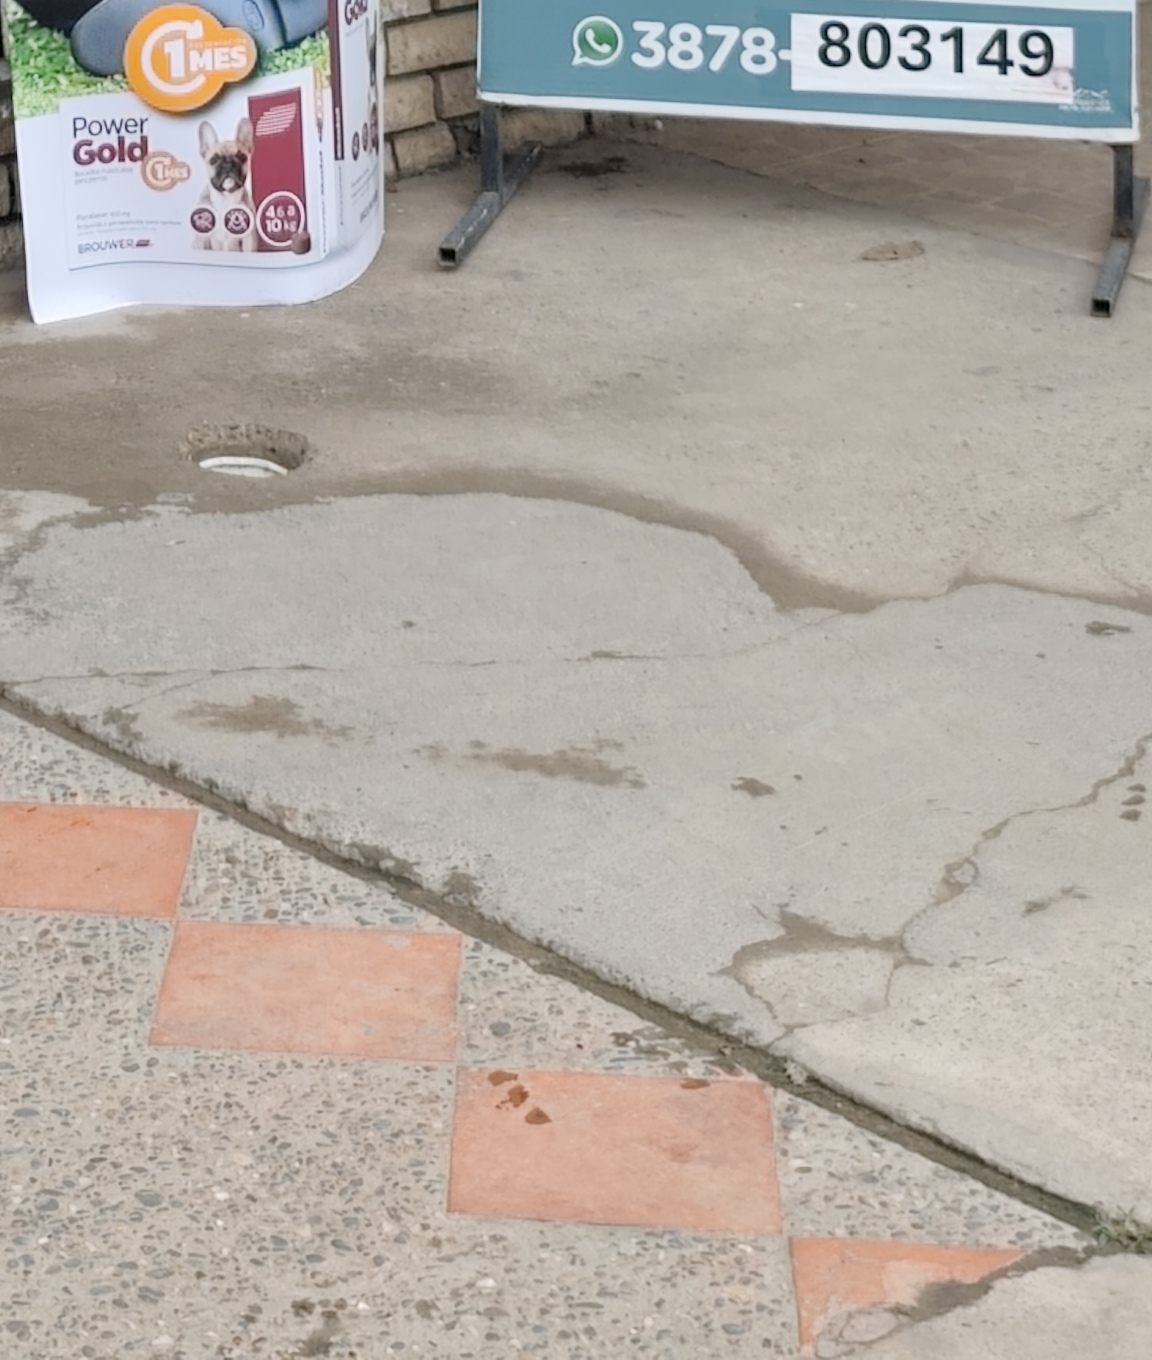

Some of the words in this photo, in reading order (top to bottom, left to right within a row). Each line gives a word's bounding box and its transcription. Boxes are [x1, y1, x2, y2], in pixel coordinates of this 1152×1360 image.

[163, 37, 186, 78] 1
[189, 44, 248, 71] MES
[816, 20, 1055, 78] 803149
[72, 117, 149, 138] Power
[73, 135, 148, 166] Gold
[265, 218, 283, 233] 10
